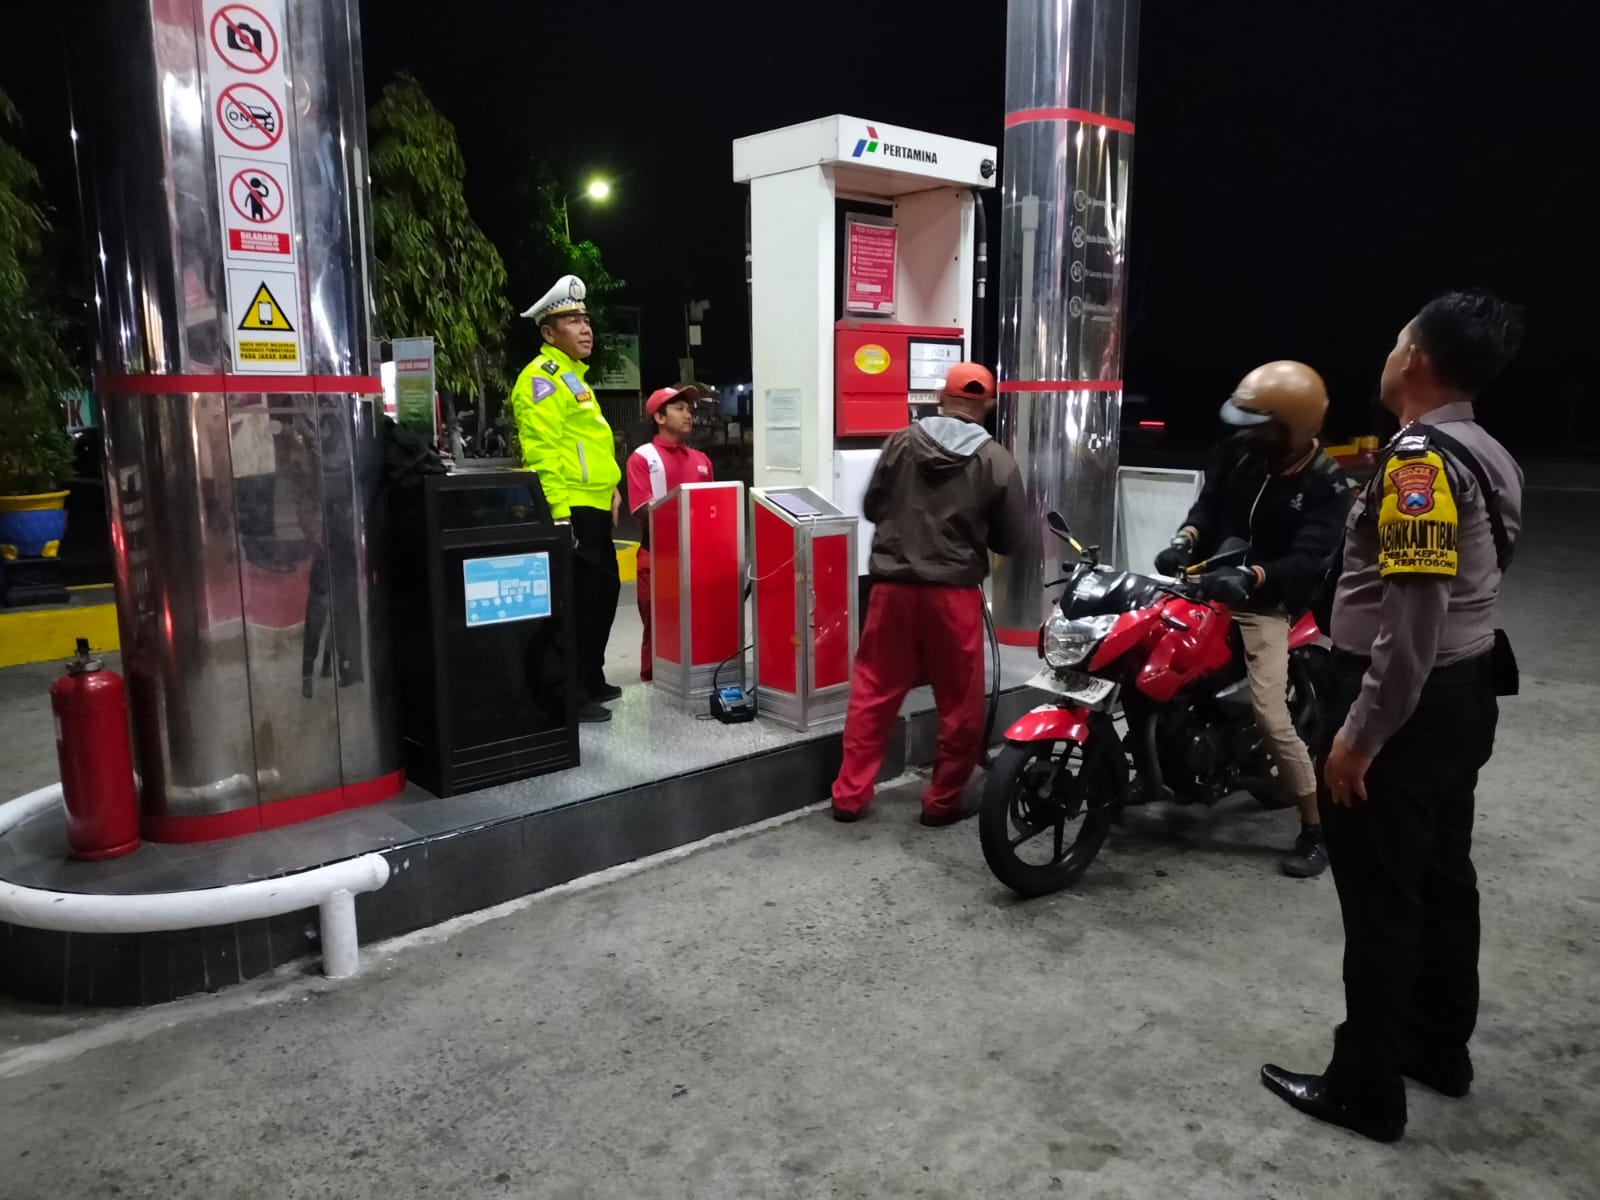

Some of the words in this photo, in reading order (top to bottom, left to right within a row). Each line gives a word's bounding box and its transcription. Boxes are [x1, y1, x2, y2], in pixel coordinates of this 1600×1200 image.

[883, 142, 938, 165] PERTAMINA
[240, 231, 279, 241] DILARANG
[1384, 551, 1408, 560] DESA
[1414, 549, 1448, 559] KEPUH
